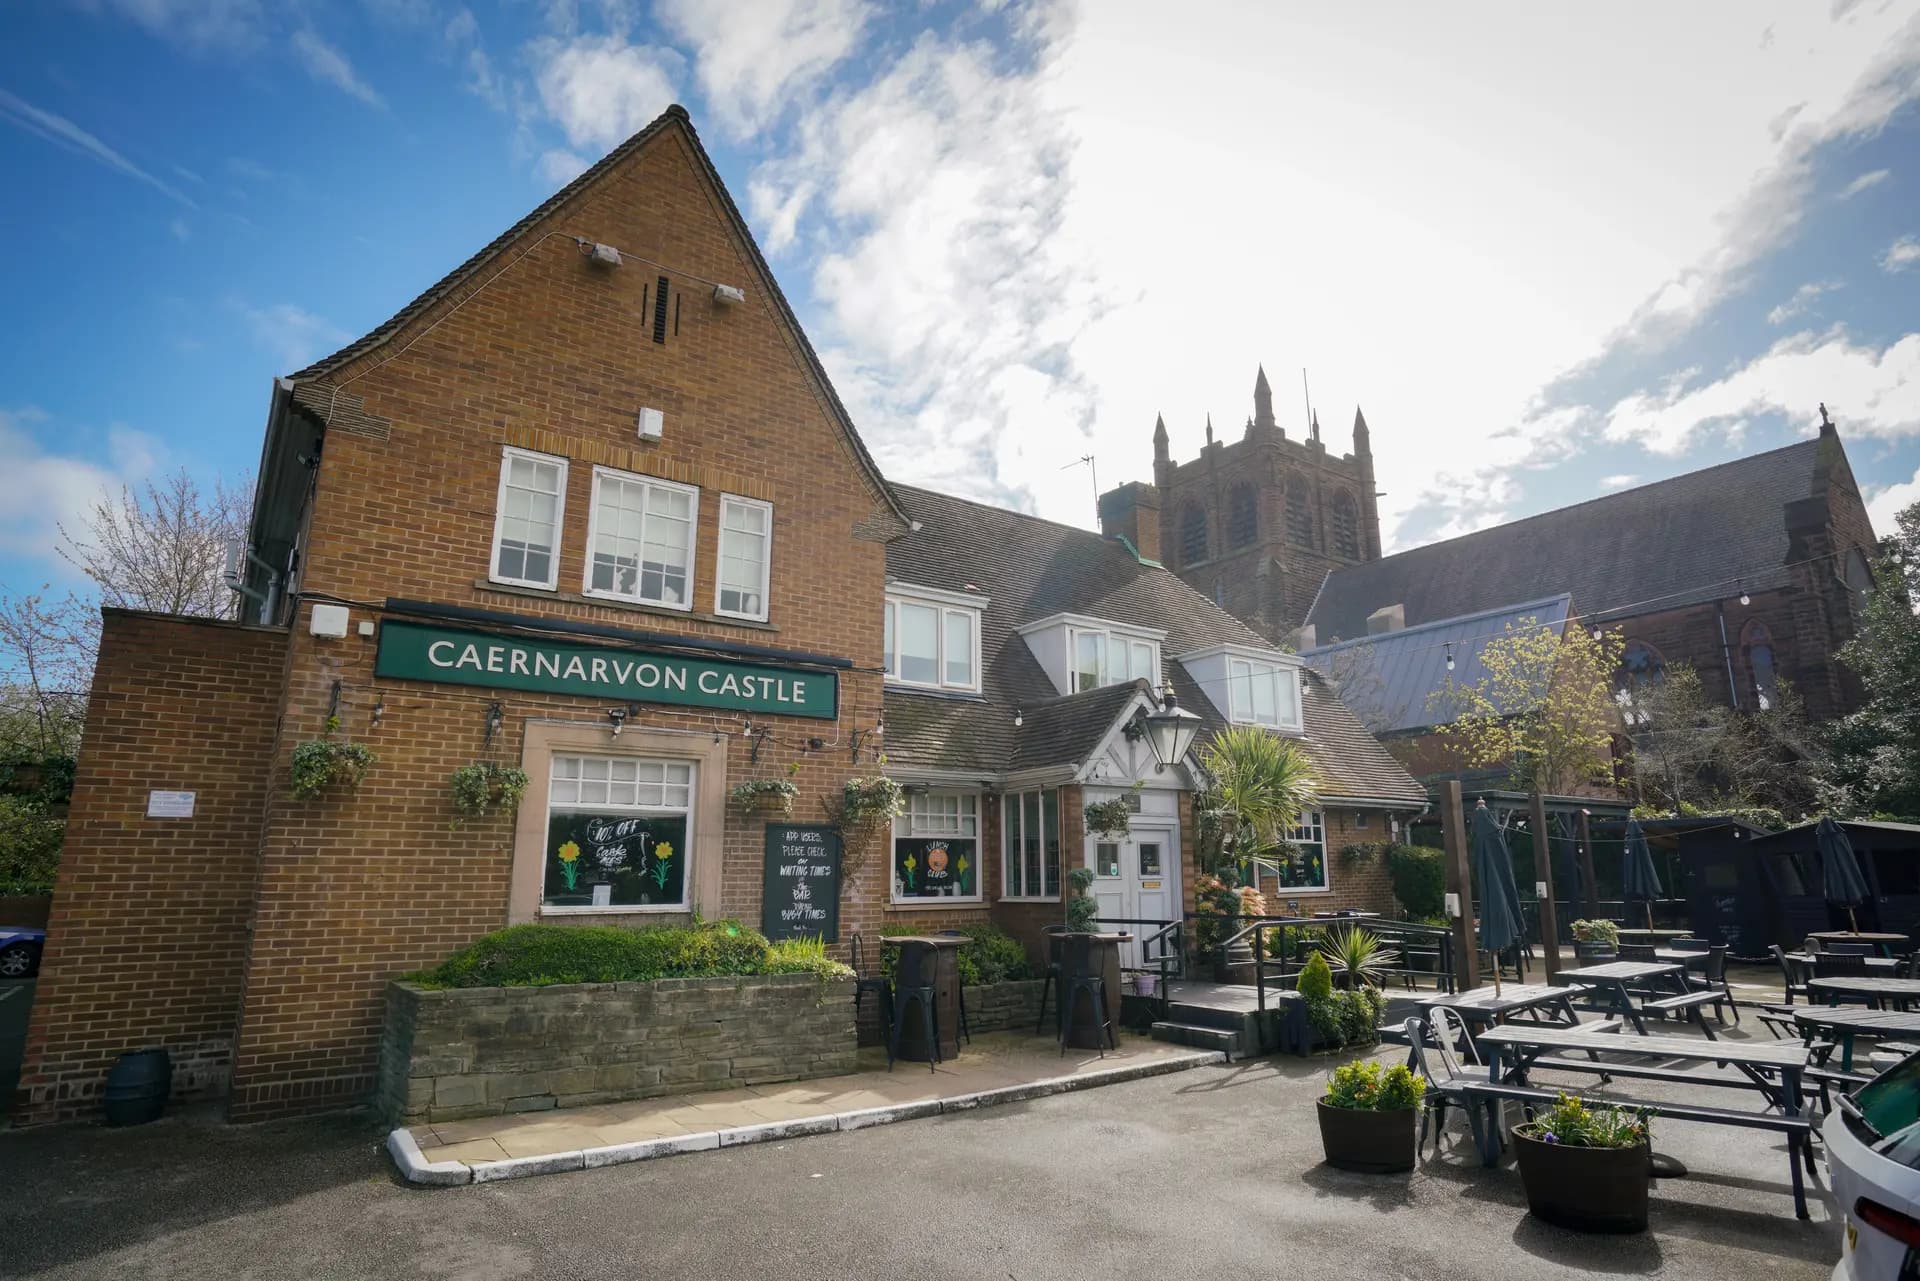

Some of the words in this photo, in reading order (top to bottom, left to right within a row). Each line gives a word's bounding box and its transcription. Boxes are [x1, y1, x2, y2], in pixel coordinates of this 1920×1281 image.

[428, 640, 687, 690] CAERNARVON
[698, 670, 806, 703] CASTLE
[595, 826, 614, 841] 10%
[617, 820, 640, 834] OFF
[783, 845, 806, 857] PLEASE
[807, 847, 827, 857] CHECK
[926, 841, 949, 852] LUNCH
[780, 865, 808, 876] WAITING
[810, 866, 831, 876] TIMES
[927, 869, 948, 878] CLUB
[792, 889, 811, 900] BAR
[781, 910, 802, 920] BUSY
[805, 909, 826, 920] TIMES
